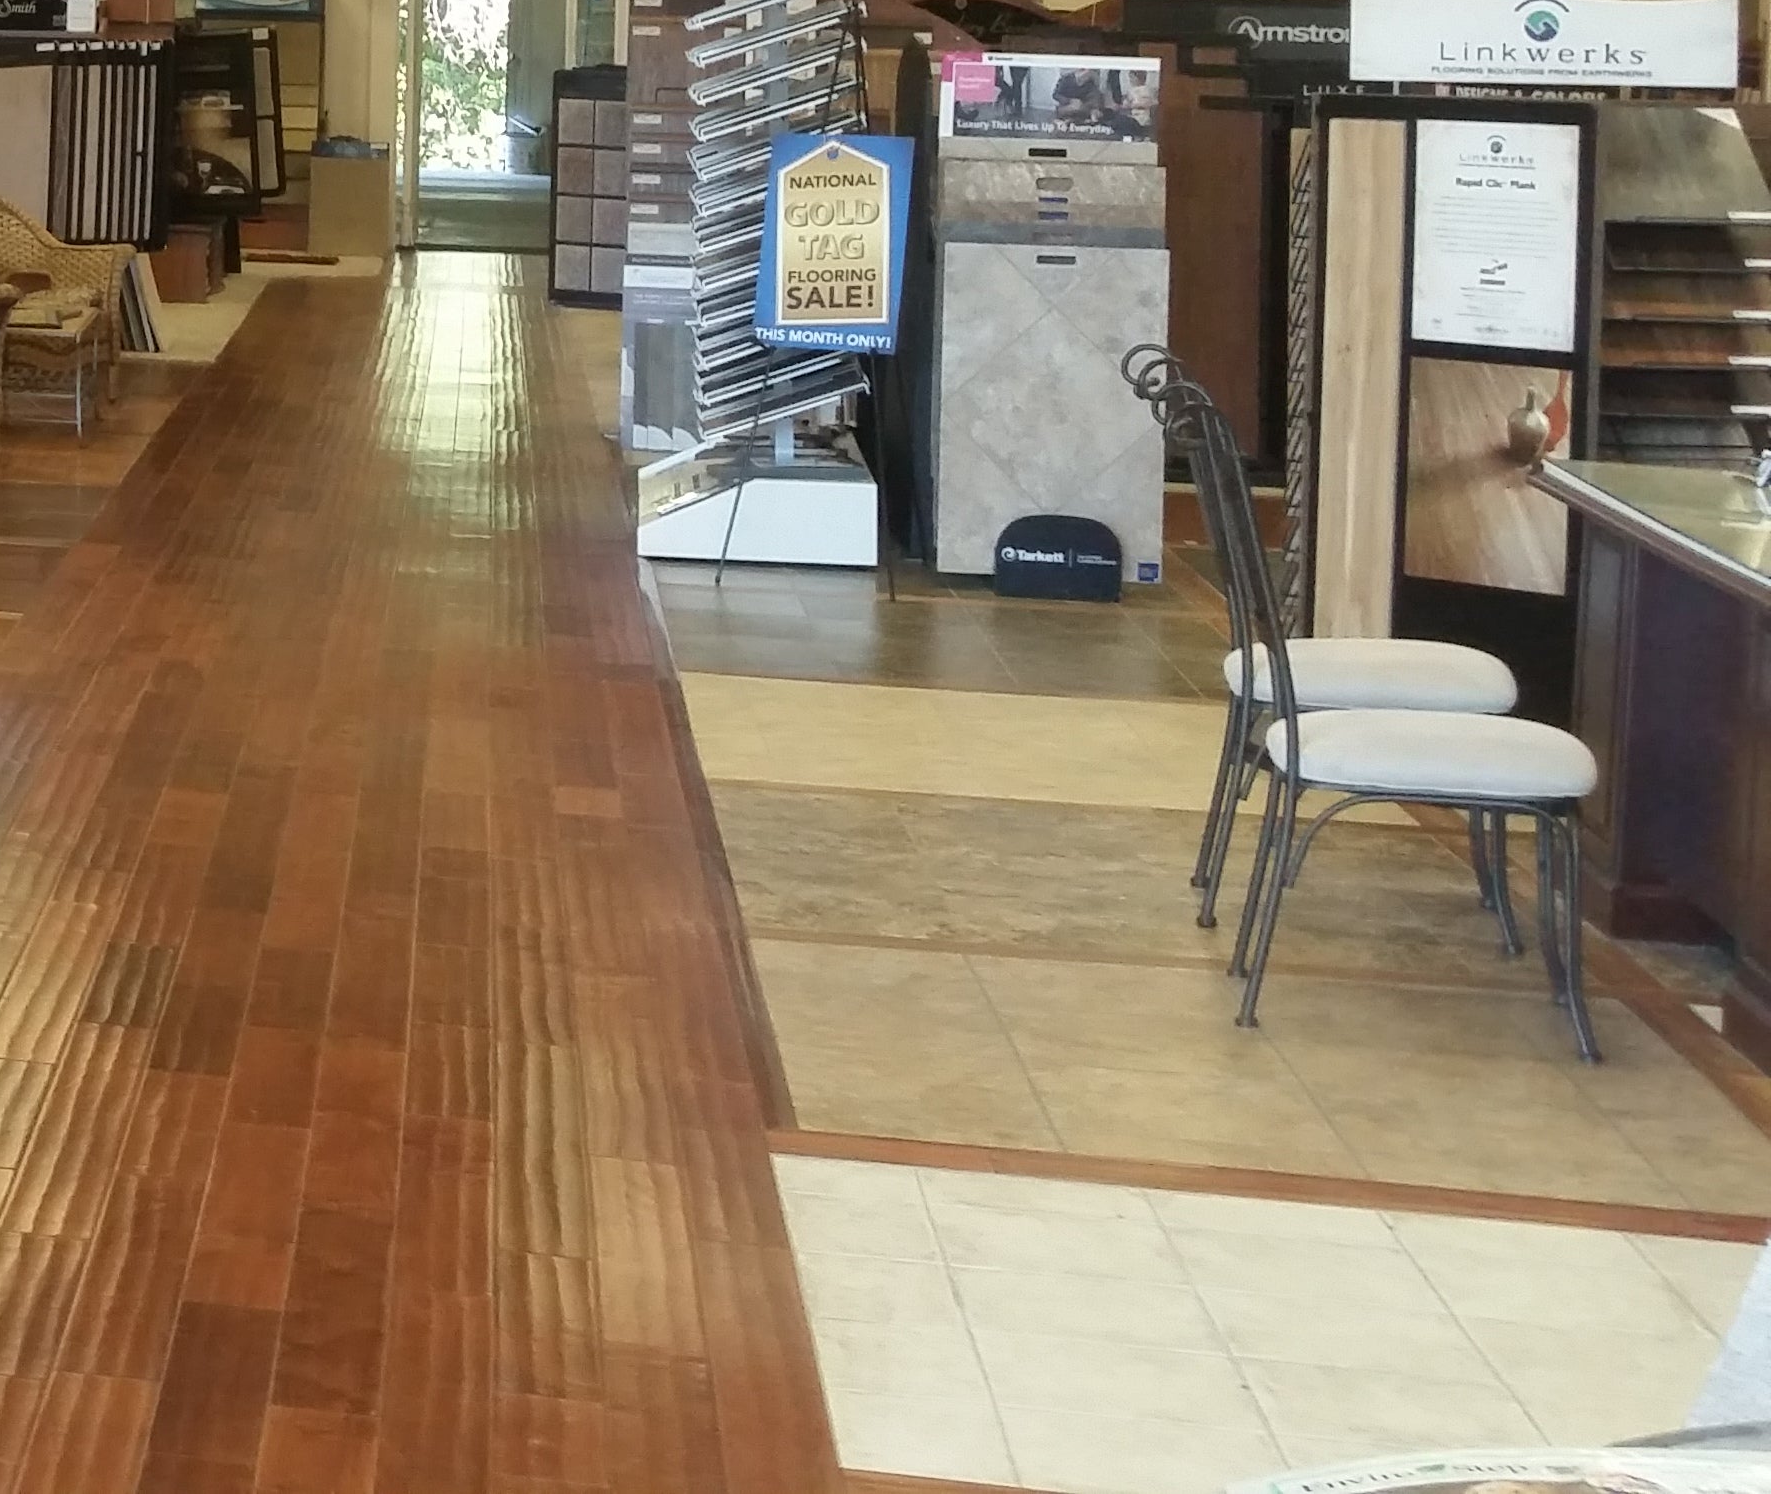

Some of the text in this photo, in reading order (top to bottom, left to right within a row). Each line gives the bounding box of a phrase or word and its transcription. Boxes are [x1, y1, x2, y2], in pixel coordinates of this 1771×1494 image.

[1439, 41, 1647, 65] Linkwerks
[991, 121, 1013, 130] That
[789, 172, 878, 190] NATIONAL
[783, 198, 881, 228] GOLD
[798, 233, 865, 261] TAG
[787, 268, 877, 284] FLOORING
[786, 285, 875, 310] SALE!
[755, 326, 892, 349] THIS MONTH ONLY!
[1016, 549, 1065, 564] Tarkett
